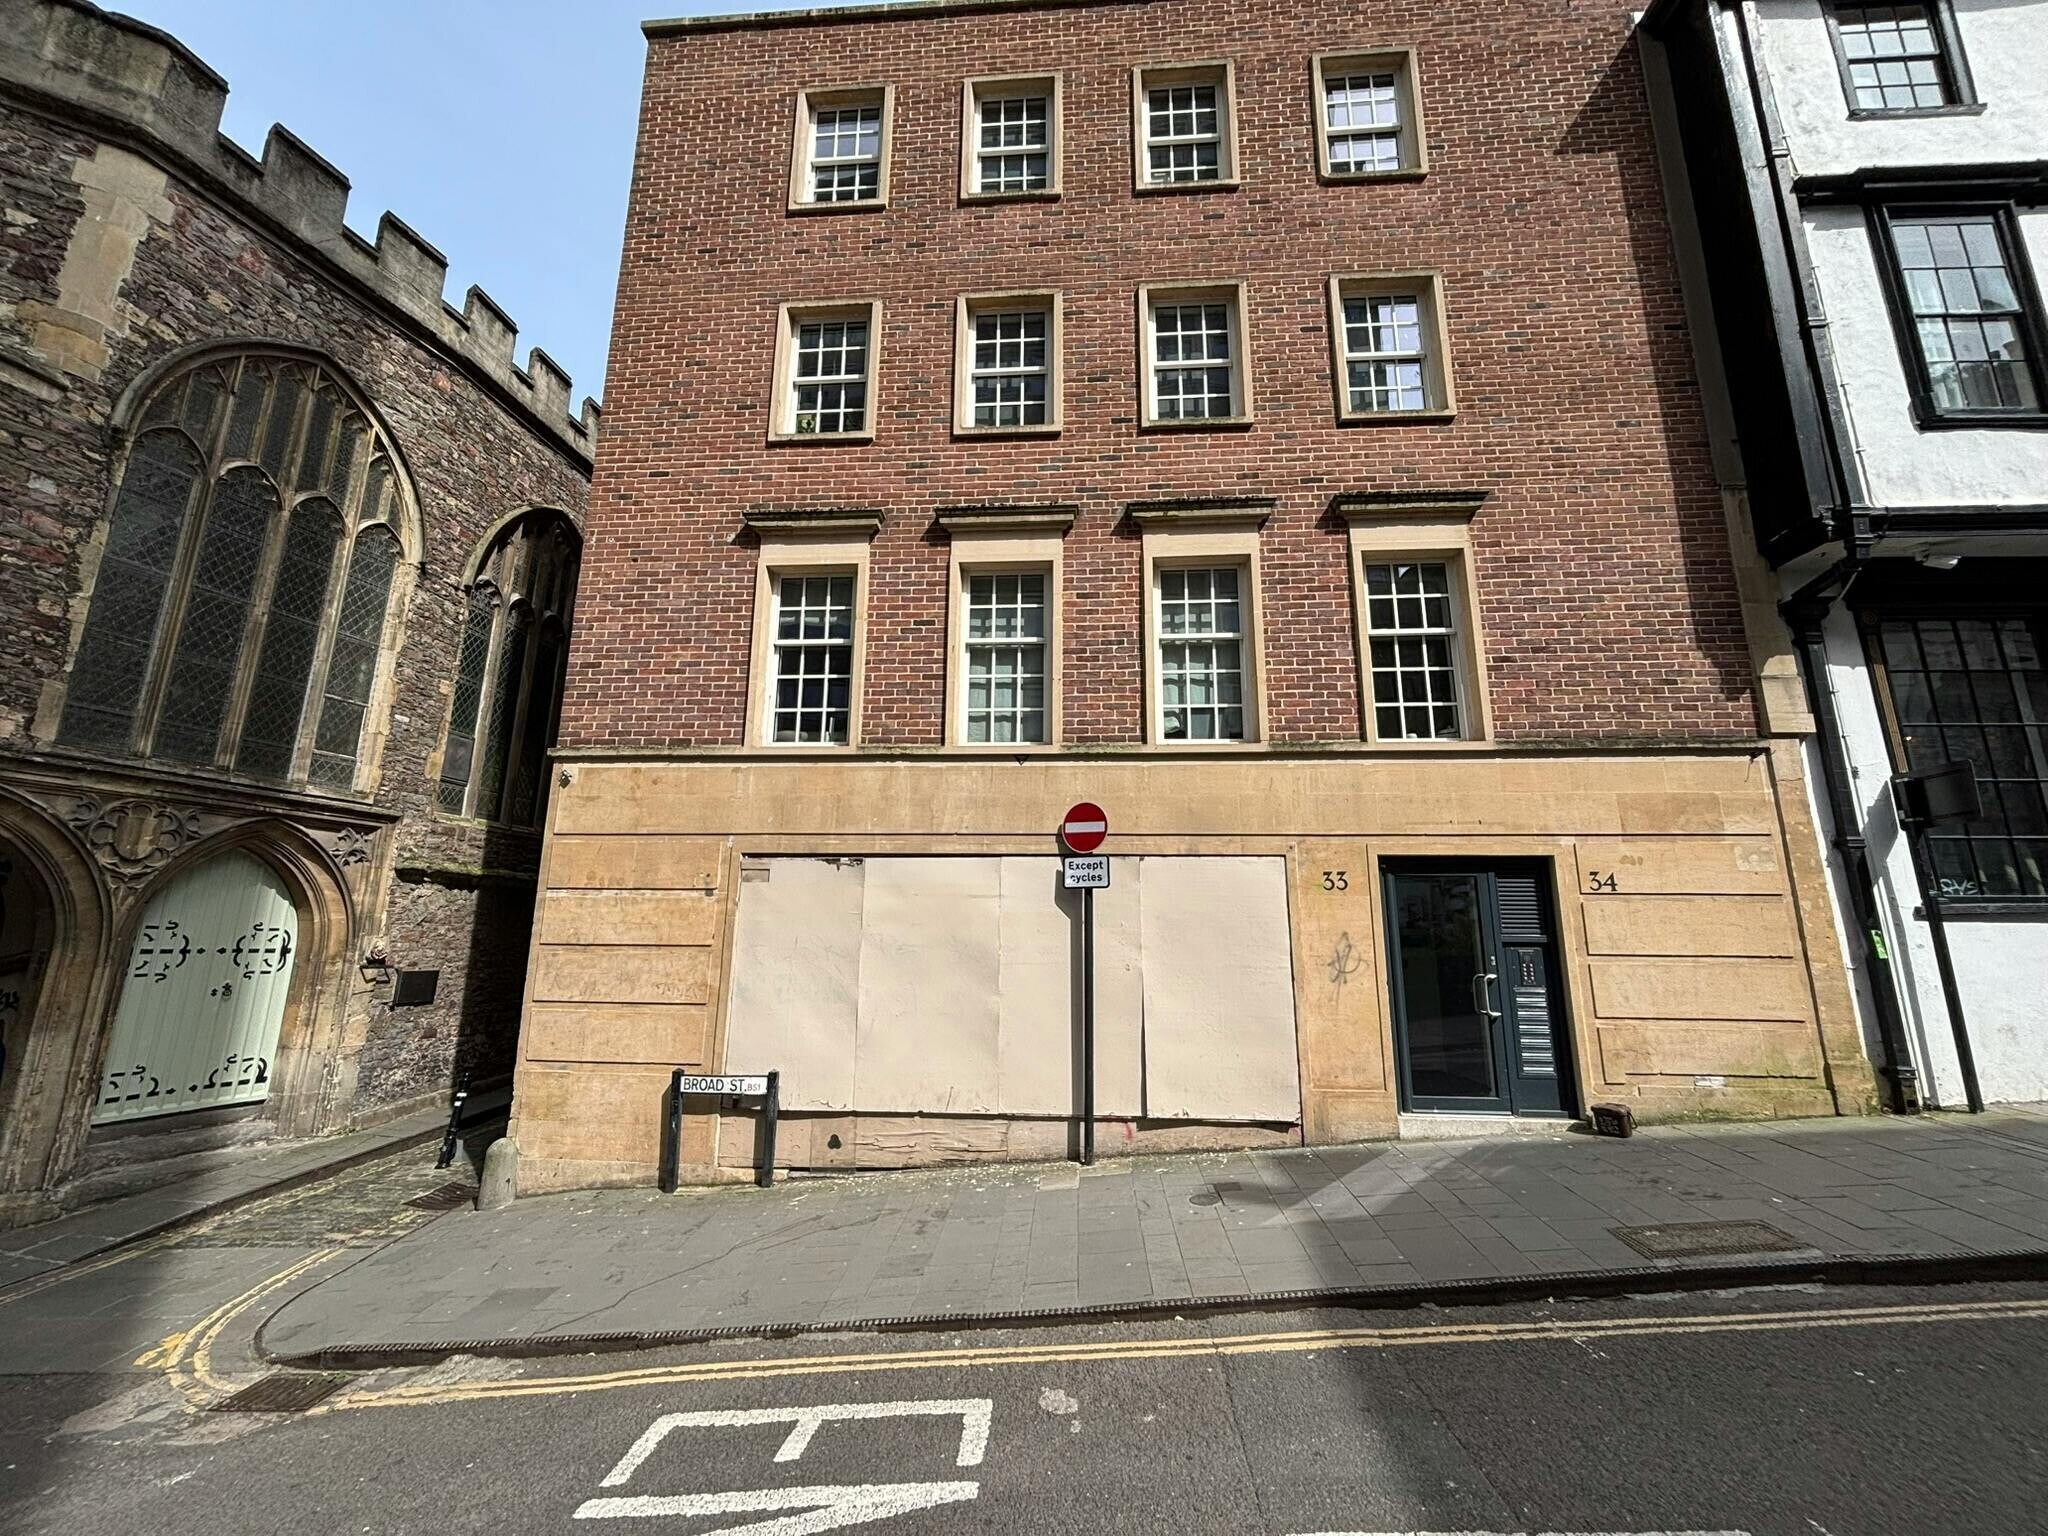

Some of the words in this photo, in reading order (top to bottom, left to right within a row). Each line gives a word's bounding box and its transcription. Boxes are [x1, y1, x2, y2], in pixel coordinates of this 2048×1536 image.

[1068, 861, 1104, 872] Except
[1070, 873, 1103, 884] cycles
[1322, 871, 1348, 891] 33
[1589, 871, 1618, 891] 34
[683, 1078, 725, 1091] BROAD
[729, 1079, 747, 1092] ST.
[747, 1083, 761, 1092] BS1
